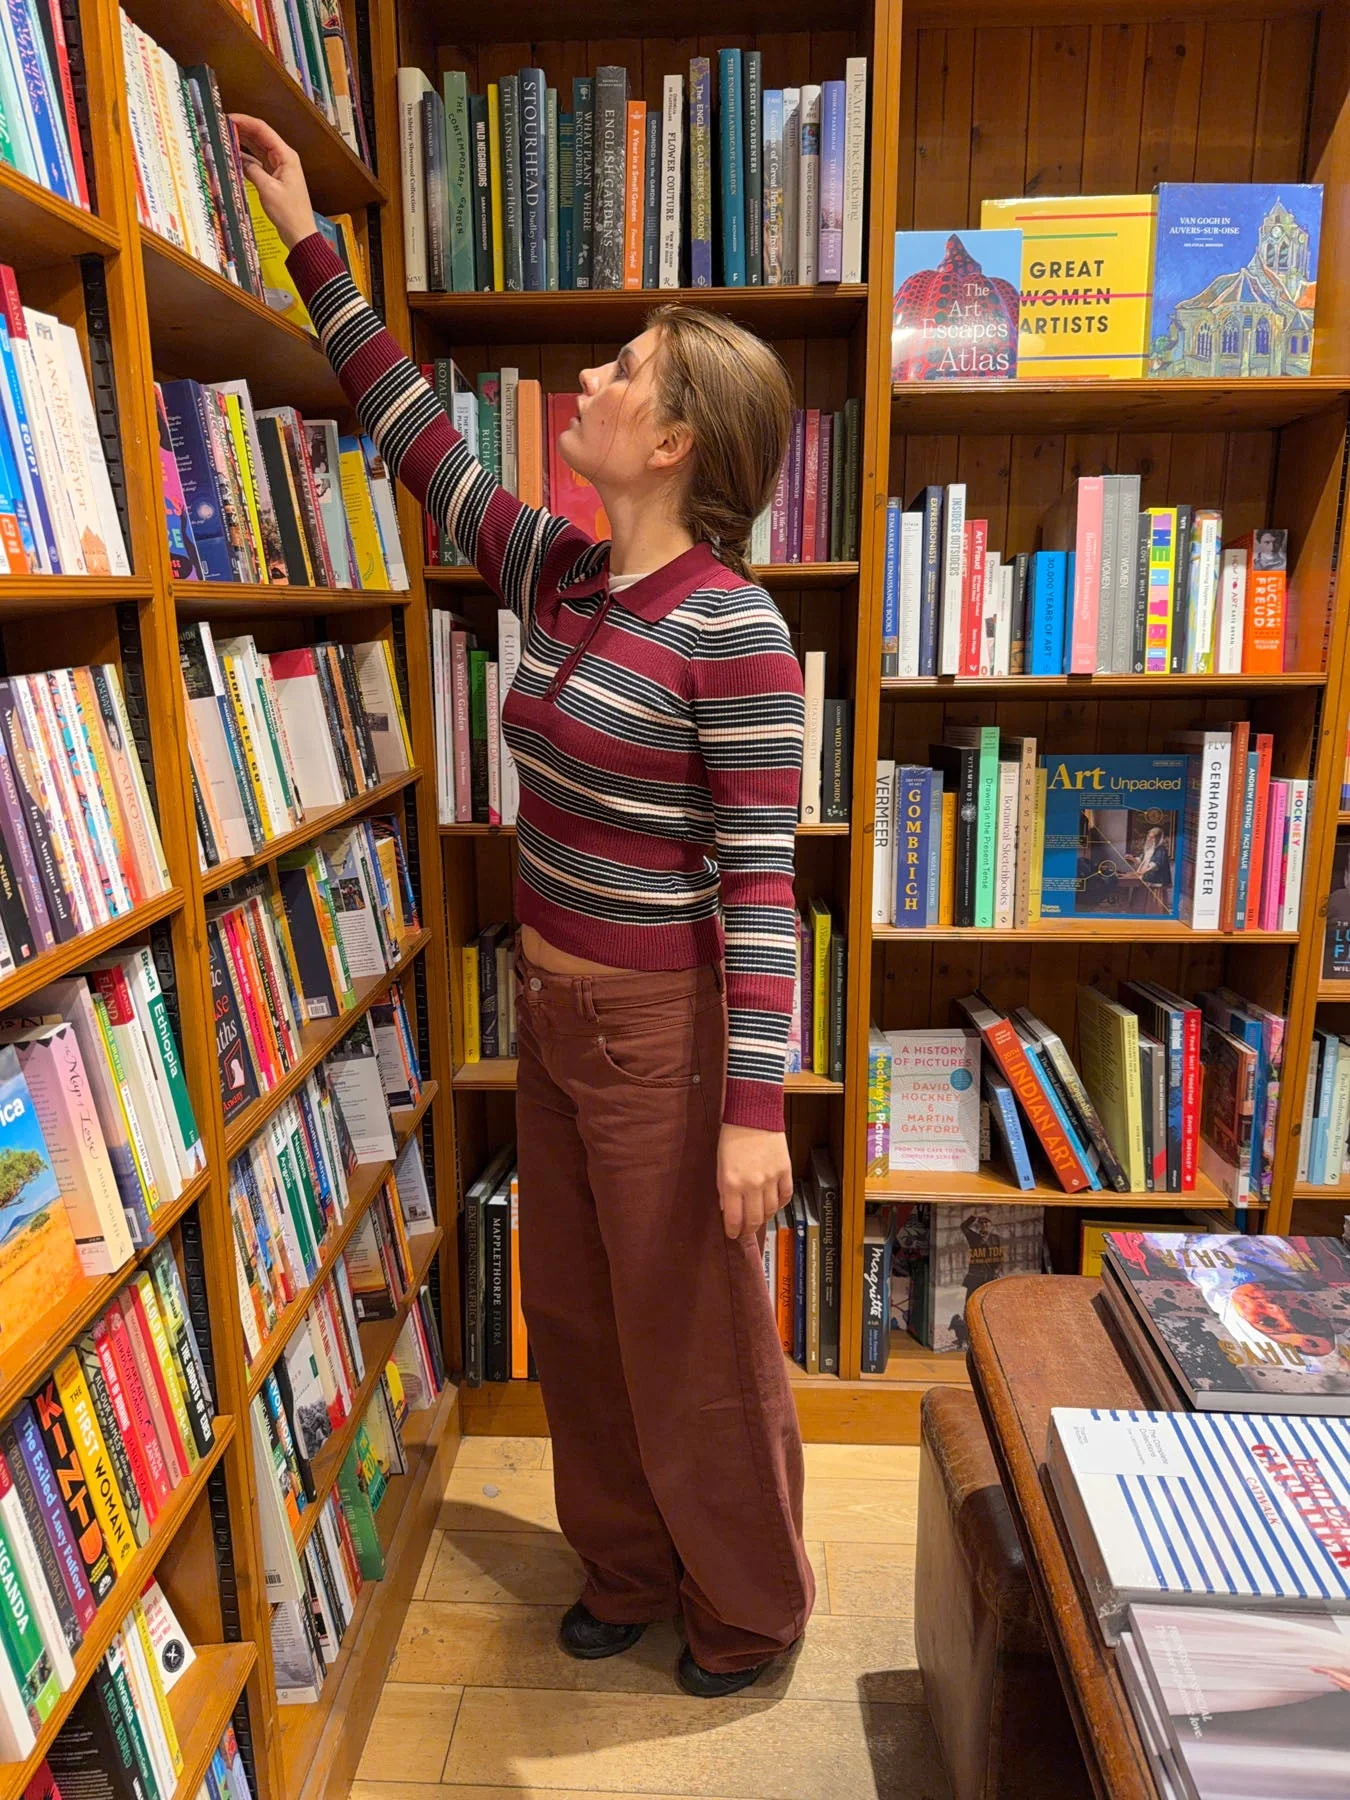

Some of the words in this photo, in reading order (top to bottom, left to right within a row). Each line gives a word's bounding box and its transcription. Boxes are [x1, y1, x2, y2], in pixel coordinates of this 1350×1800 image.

[749, 61, 757, 80] THE
[406, 102, 414, 116] The
[456, 95, 465, 114] THE
[696, 85, 705, 100] The
[727, 76, 735, 113] ENGLISH
[749, 82, 757, 117] SECRET
[406, 116, 414, 141] Shirley
[476, 121, 486, 140] WILD
[583, 111, 593, 148] WHAT
[696, 104, 705, 141] ENGLISH
[728, 114, 736, 161] LANDSCAPE
[407, 141, 416, 177] Sherwood
[447, 112, 466, 188] CONTEMPORARY
[523, 81, 540, 206] STOURHEAD
[575, 111, 583, 186] ENCYCLOPEDIA
[604, 109, 616, 175] ENGLISH
[666, 131, 677, 172] FLOWER
[749, 118, 758, 174] GARDENERS
[477, 141, 488, 187] NEIGHBOURS
[583, 151, 593, 188] PLANT
[697, 144, 706, 200] GARDENER'S
[729, 162, 737, 195] GARDEN
[805, 161, 813, 193] WILDLIFE
[408, 177, 417, 214] Collection
[583, 191, 593, 232] WHERE
[602, 178, 615, 248] GARDENS
[665, 175, 676, 222] COUTURE
[455, 197, 467, 235] GARDEN
[527, 211, 537, 240] Dudley
[697, 203, 706, 240] GARDEN
[805, 194, 813, 237] GARDENING
[1168, 226, 1240, 235] AUVERS-SUR-OISE
[1179, 217, 1196, 225] VAN
[1197, 217, 1220, 225] GOGH
[1221, 217, 1231, 225] IN
[529, 241, 539, 264] Dodd
[1029, 259, 1105, 280] GREAT
[963, 282, 990, 298] The
[1020, 287, 1112, 308] WOMEN
[948, 299, 981, 318] Art
[1019, 314, 1109, 335] ARTISTS
[921, 318, 1009, 343] Escapes
[936, 346, 1010, 373] Atlas
[438, 362, 448, 398] ROYAL
[505, 382, 515, 417] Beatrix
[240, 407, 251, 432] THE
[492, 412, 503, 457] FLORA
[505, 419, 515, 455] Farrand
[20, 422, 39, 477] EGYPT
[242, 434, 256, 476] LAGOS
[252, 479, 262, 512] WIFE
[927, 497, 938, 565] EXPRESSIONISTS
[951, 497, 963, 533] INSIDERS
[886, 512, 896, 559] REMARKABLE
[975, 530, 984, 545] Art
[949, 535, 962, 577] OUTSIDERS
[974, 546, 983, 570] Fraud
[1045, 557, 1056, 589] 30,000
[1139, 567, 1146, 576] IT
[885, 560, 895, 607] RENAISSANCE
[1044, 591, 1055, 621] YEARS
[1137, 613, 1144, 622] IT
[1138, 600, 1144, 610] IS
[1253, 577, 1266, 628] FREUD
[1264, 576, 1278, 628] LUCIAN
[884, 609, 894, 633] BOOKS
[1044, 623, 1053, 637] OF
[455, 641, 465, 660] The
[1043, 639, 1053, 658] ART
[456, 661, 467, 697] Writer's
[487, 671, 498, 716] FLOWERS
[114, 686, 136, 750] NASSER
[228, 669, 245, 716] DON'T
[241, 725, 254, 753] LET
[250, 761, 260, 783] GO
[259, 683, 276, 741] Zimbabwe
[456, 698, 467, 732] Garden
[3, 706, 22, 750] Amitav
[15, 752, 34, 793] Ghosh
[488, 717, 499, 746] EVERY
[833, 726, 843, 748] WILD
[489, 746, 500, 765] DAY
[832, 748, 842, 779] FLOWER
[116, 756, 141, 820] CAIRO
[832, 778, 842, 803] GUIDE
[983, 777, 995, 812] Drawing
[1022, 746, 1033, 833] BANKSY
[1046, 762, 1107, 791] Art
[1109, 776, 1183, 793] Unpacked
[1245, 767, 1256, 800] ANDREW
[28, 804, 40, 819] In
[874, 774, 892, 848] VERMEER
[1205, 760, 1223, 832] GERHARD
[34, 821, 44, 837] an
[982, 821, 992, 835] the
[983, 812, 992, 821] in
[1001, 794, 1014, 841] Botanical
[1244, 800, 1255, 829] FESTING
[1292, 789, 1305, 847] HOCKNEY
[904, 788, 923, 911] GOMBRICH
[981, 835, 991, 866] Present
[1240, 849, 1250, 869] VALUE
[1241, 833, 1252, 850] FACE
[38, 839, 60, 886] Antique
[980, 867, 990, 890] Tense
[999, 842, 1012, 906] Sketchbooks
[1201, 835, 1219, 897] RICHTER
[51, 888, 68, 920] Land
[139, 949, 157, 994] Bradt
[98, 974, 121, 1021] ELAND
[151, 1002, 181, 1079] Ethiopia
[901, 1047, 910, 1055] A
[914, 1046, 966, 1055] HISTORY
[893, 1057, 911, 1066] OF
[914, 1057, 972, 1067] PICTURES
[876, 1052, 888, 1111] Hockney's
[901, 1093, 961, 1102] HOCKNEY
[912, 1082, 950, 1091] DAVID
[901, 1124, 960, 1134] GAYFORD
[907, 1114, 955, 1123] MARTIN
[1008, 1059, 1056, 1134] INDIAN
[1044, 1135, 1078, 1172] ART
[306, 1112, 321, 1159] Southern
[317, 1160, 328, 1188] Africa
[874, 1112, 887, 1159] Pictures
[822, 1190, 835, 1245] Capturing
[467, 1204, 478, 1286] EXPERIENCING
[492, 1217, 502, 1307] MAPPLETHORPE
[824, 1246, 836, 1283] Nature
[467, 1287, 478, 1328] AFRICA
[492, 1310, 503, 1346] FLORA
[179, 1339, 195, 1364] THE
[1217, 1339, 1306, 1367] DAYS
[69, 1384, 84, 1403] THE
[185, 1364, 203, 1399] GHOSTS
[196, 1399, 207, 1413] OF
[73, 1399, 100, 1458] FIRST
[198, 1417, 213, 1442] EDEN
[21, 1416, 39, 1451] The
[31, 1446, 57, 1508] Exiled
[50, 1511, 70, 1546] Lucy
[63, 1546, 87, 1600] Fulford
[94, 1456, 126, 1545] WOMAN
[1245, 1476, 1281, 1526] CATWALK
[114, 1670, 134, 1721] Rwanda
